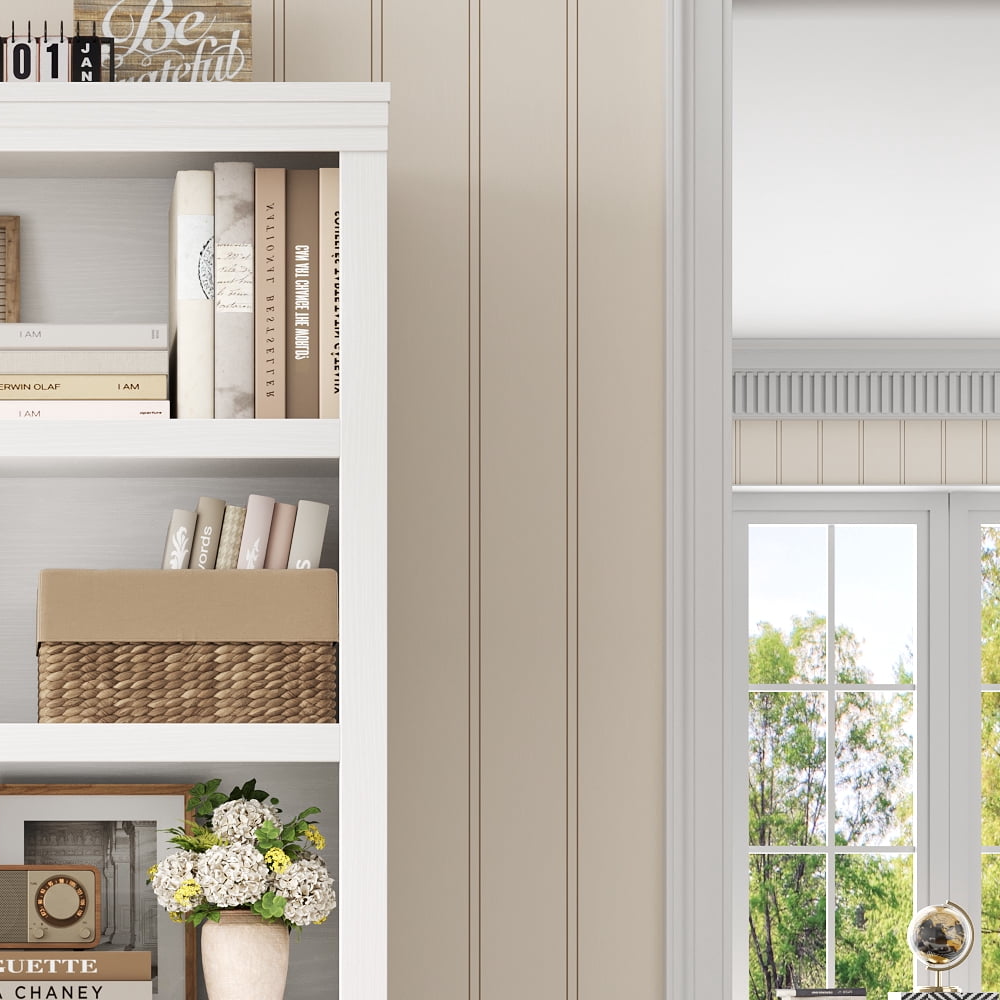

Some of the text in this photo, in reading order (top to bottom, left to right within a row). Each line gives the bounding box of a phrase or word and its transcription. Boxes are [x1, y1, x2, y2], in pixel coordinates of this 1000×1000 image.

[33, 383, 61, 391] OLAF
[122, 383, 140, 391] AM
[24, 410, 41, 418] AM
[14, 986, 103, 1000] CHANEY
